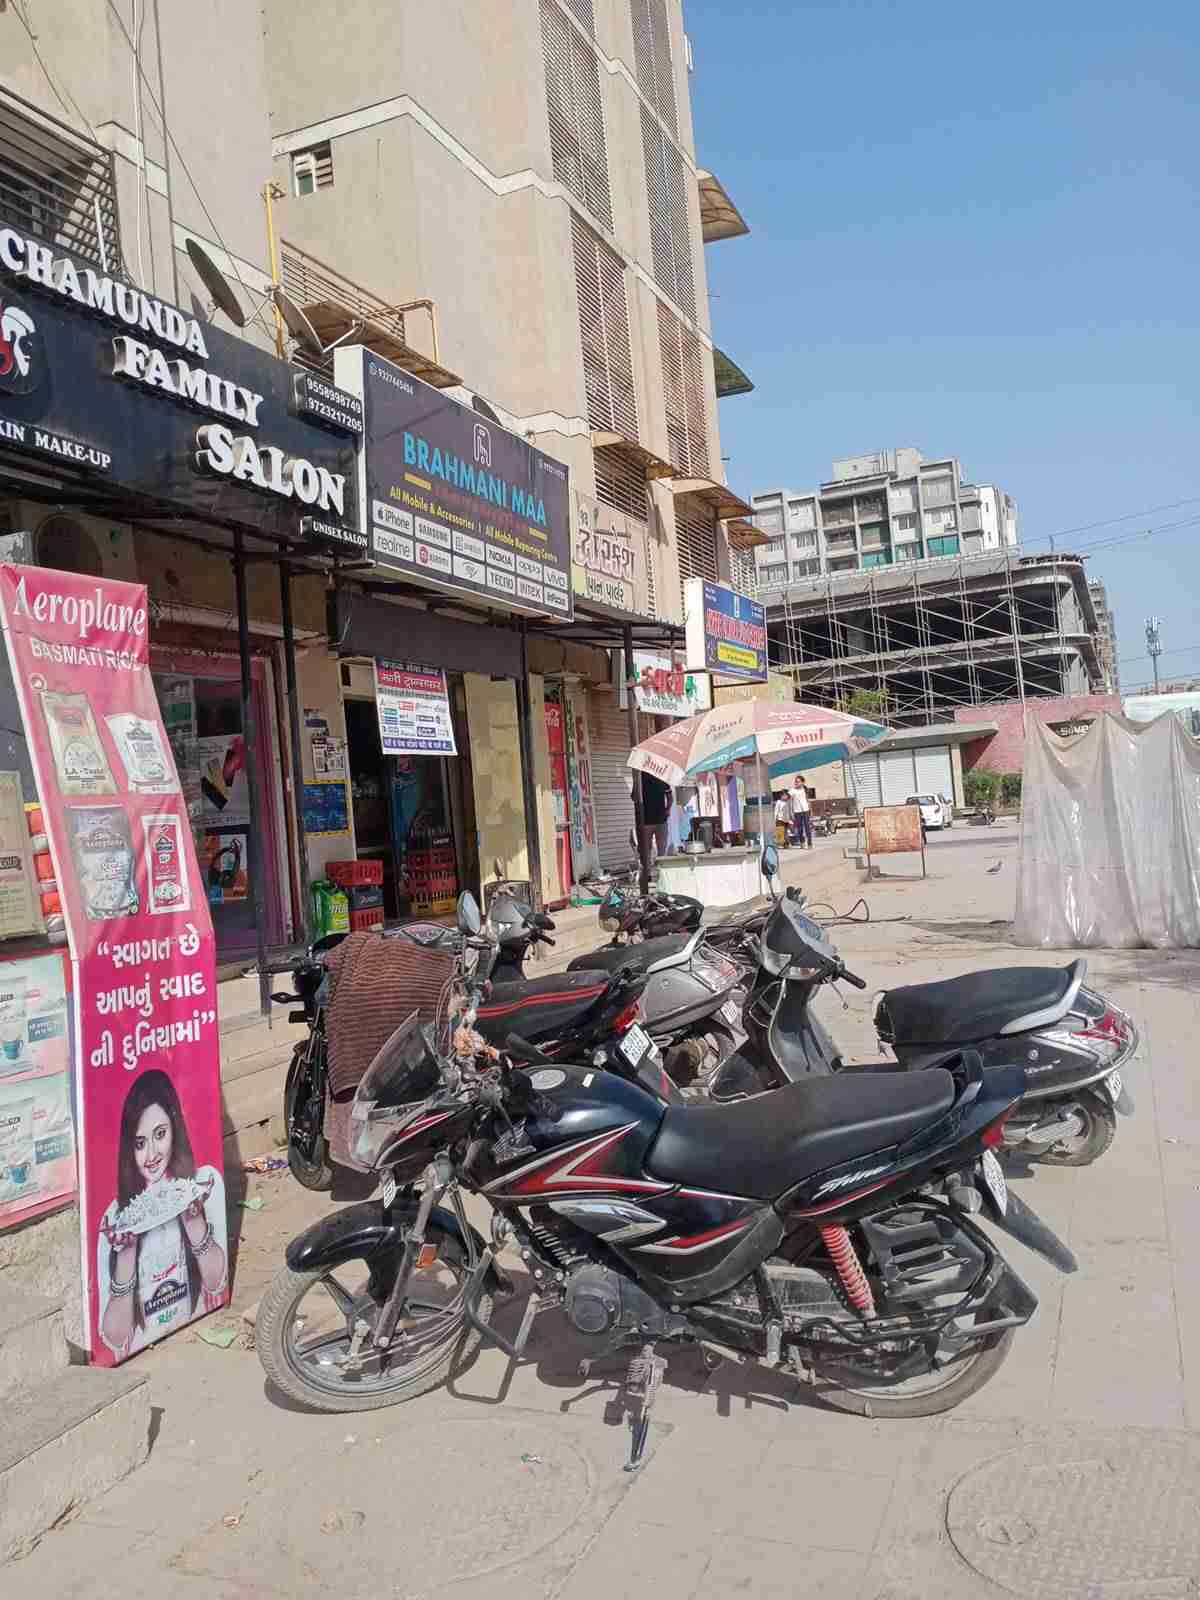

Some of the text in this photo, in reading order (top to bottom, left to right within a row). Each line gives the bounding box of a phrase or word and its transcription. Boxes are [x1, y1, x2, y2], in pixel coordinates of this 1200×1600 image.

[0, 227, 209, 359] CHAMUNDA
[114, 336, 264, 427] FAMILY
[35, 430, 112, 469] MAKE-UP
[199, 423, 346, 517] SALON
[402, 431, 508, 507] BRAHMANI
[511, 485, 547, 527] MAA
[390, 485, 401, 501] All
[401, 489, 428, 512] Mobile
[312, 519, 368, 548] UNISEX SALON
[385, 509, 411, 530] iPhone
[376, 534, 411, 558] realme
[13, 576, 147, 638] Aeroplane
[31, 637, 105, 667] BASMATI
[782, 727, 825, 747] Amul
[178, 923, 201, 956] છે
[90, 1029, 114, 1067] ની
